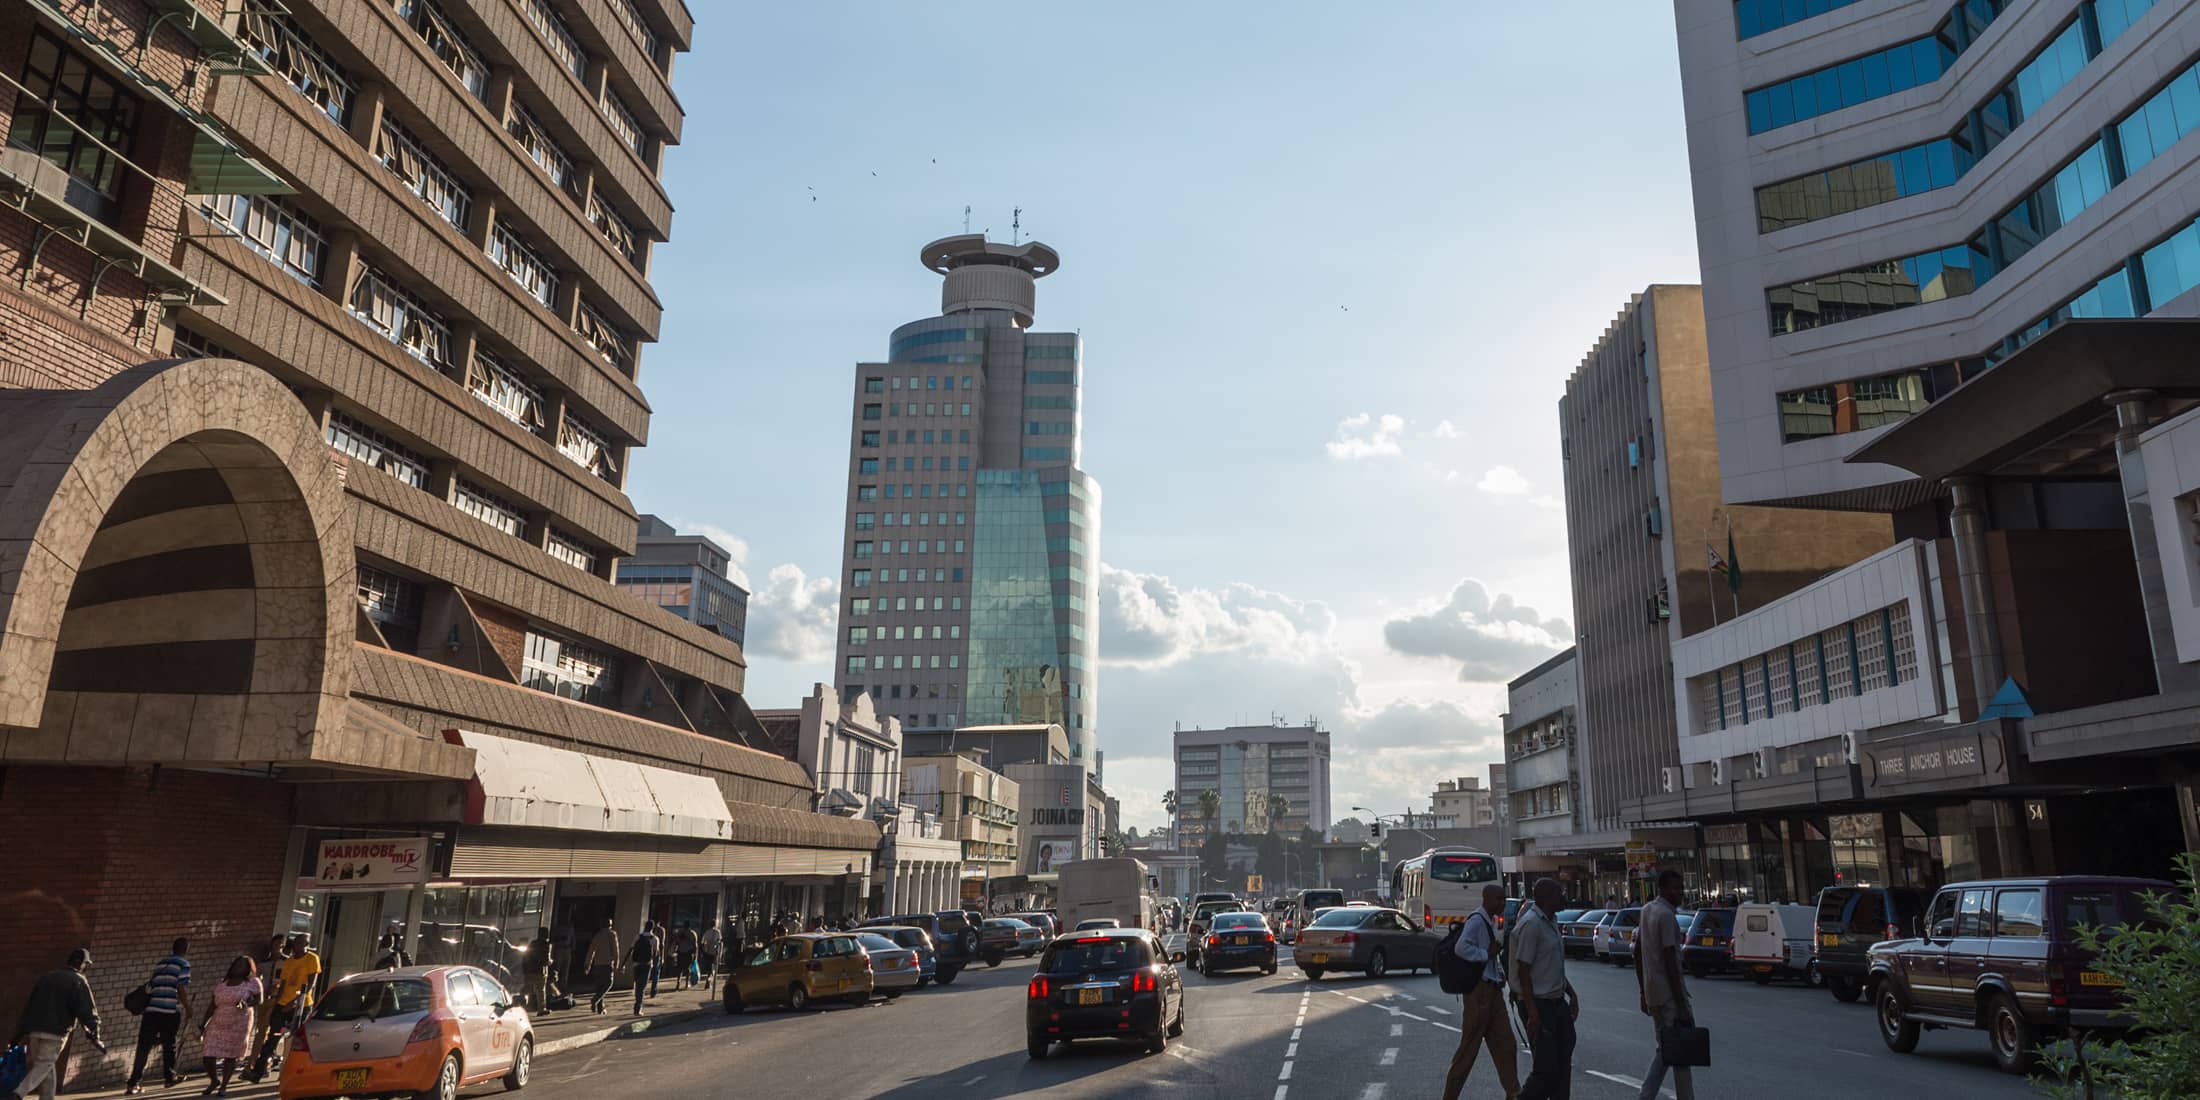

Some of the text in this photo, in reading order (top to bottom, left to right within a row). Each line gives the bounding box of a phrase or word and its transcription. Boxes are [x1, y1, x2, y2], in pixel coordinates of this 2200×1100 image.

[1880, 747, 1976, 776] THREE ANCHOR HOUSE
[1031, 808, 1066, 825] JOINA
[324, 844, 396, 859] WARDROBE
[392, 851, 420, 864] mix
